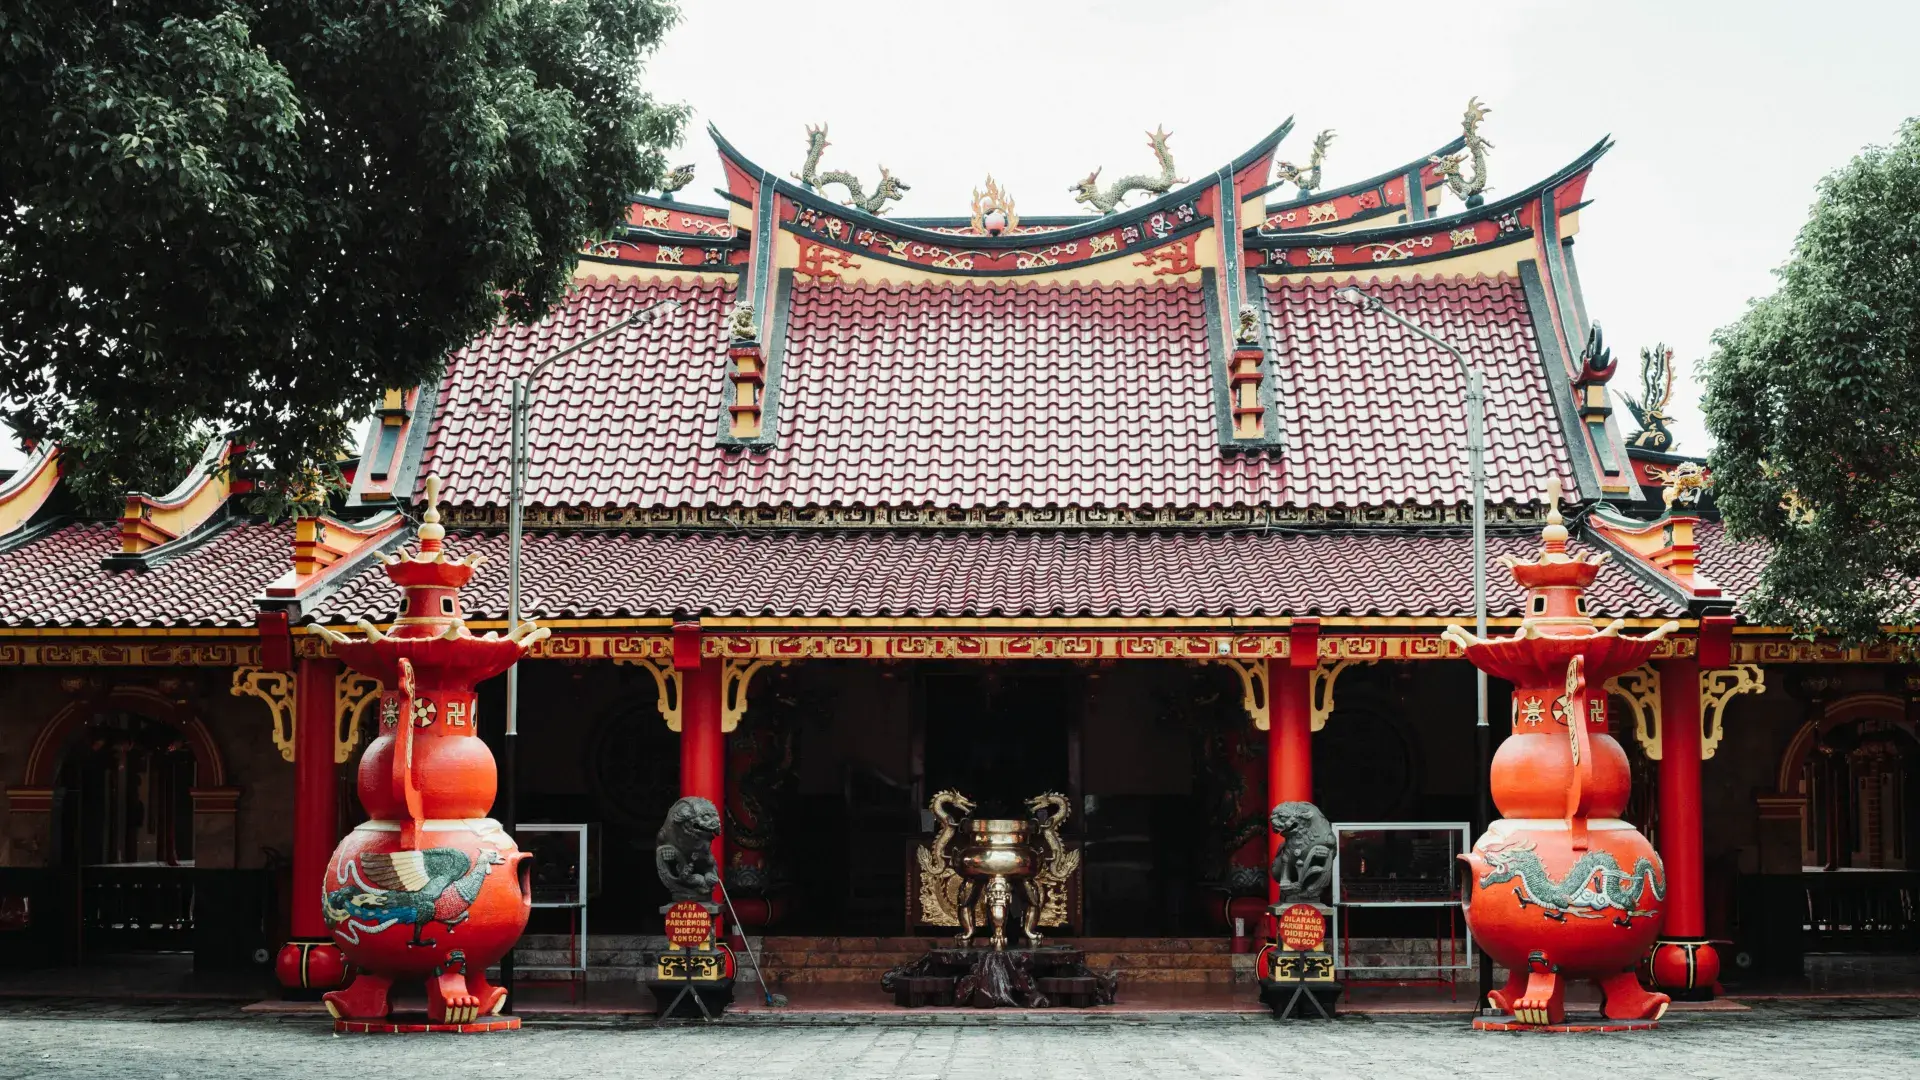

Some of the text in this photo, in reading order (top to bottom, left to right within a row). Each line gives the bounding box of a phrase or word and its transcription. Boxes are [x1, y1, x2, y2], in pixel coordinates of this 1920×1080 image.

[1291, 908, 1316, 916] MAAF
[1284, 915, 1322, 925] DILARANG
[1284, 930, 1320, 938] DIDEPAN
